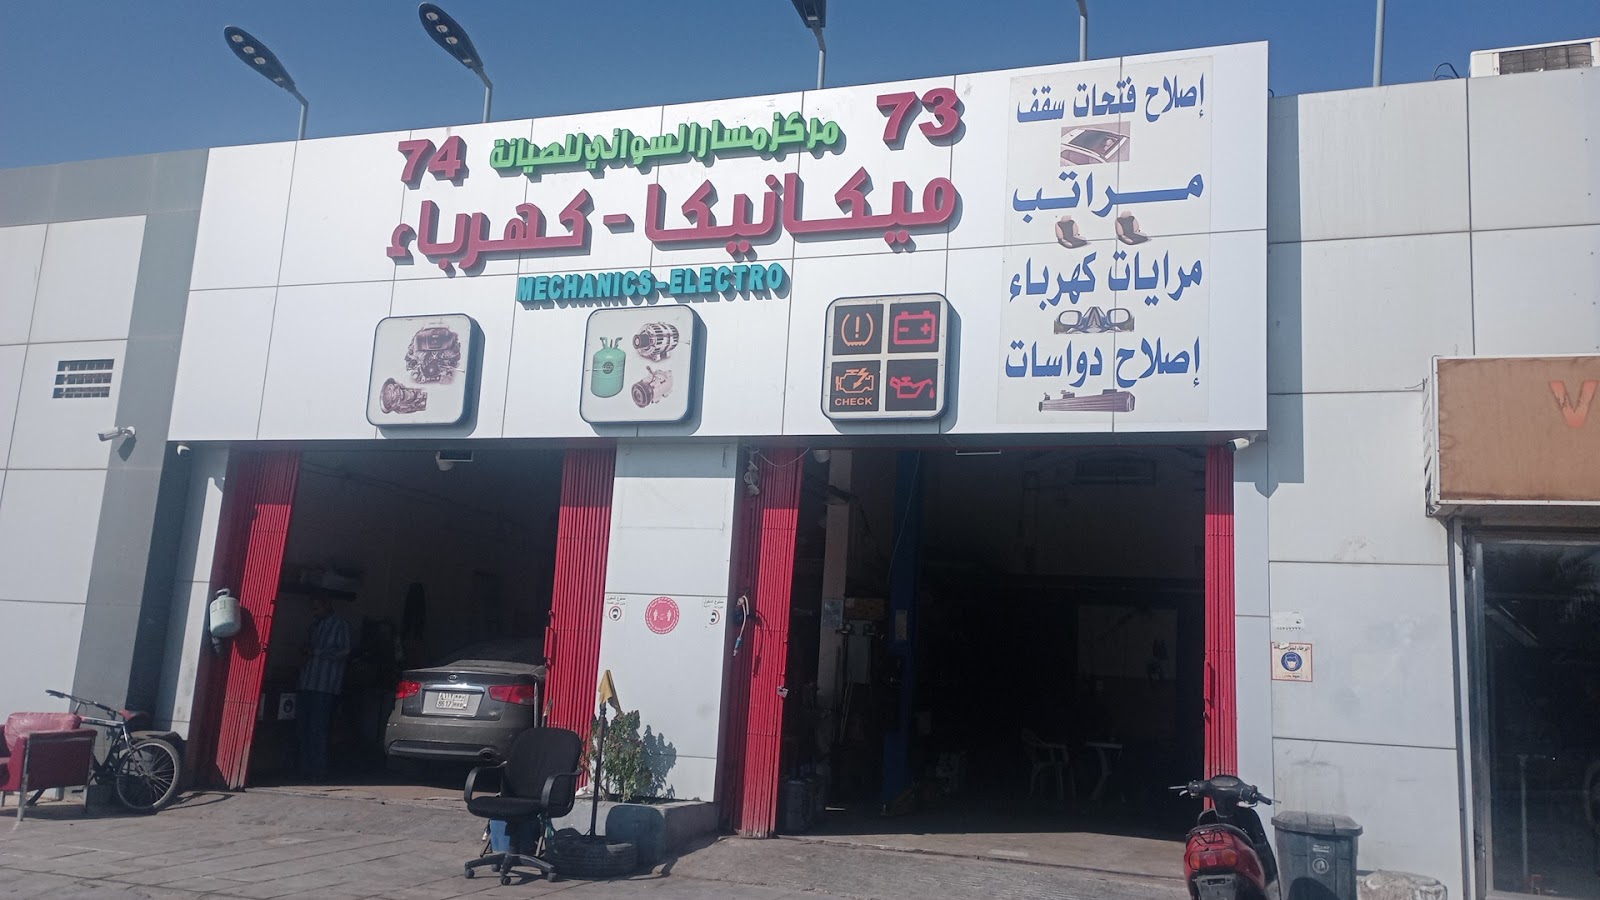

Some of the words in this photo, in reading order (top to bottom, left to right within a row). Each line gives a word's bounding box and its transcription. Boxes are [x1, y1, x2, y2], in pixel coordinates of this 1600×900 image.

[876, 88, 961, 142] 73
[1016, 85, 1065, 122] سقف
[1073, 76, 1136, 118] فتحات
[1144, 73, 1204, 122] إصلاح
[489, 131, 588, 174] للصيانة
[698, 119, 768, 157] مسار
[769, 111, 840, 151] مركز
[399, 136, 465, 182] 74
[646, 166, 957, 260] ميكانيكا
[1012, 171, 1204, 223] مراتب
[386, 188, 595, 270] كهرباء
[1009, 252, 1098, 310] كهرباء
[1108, 250, 1202, 306] مرايات
[1005, 340, 1102, 388] دواسات
[1115, 336, 1200, 388] إصلاح
[835, 397, 873, 406] CHECK
